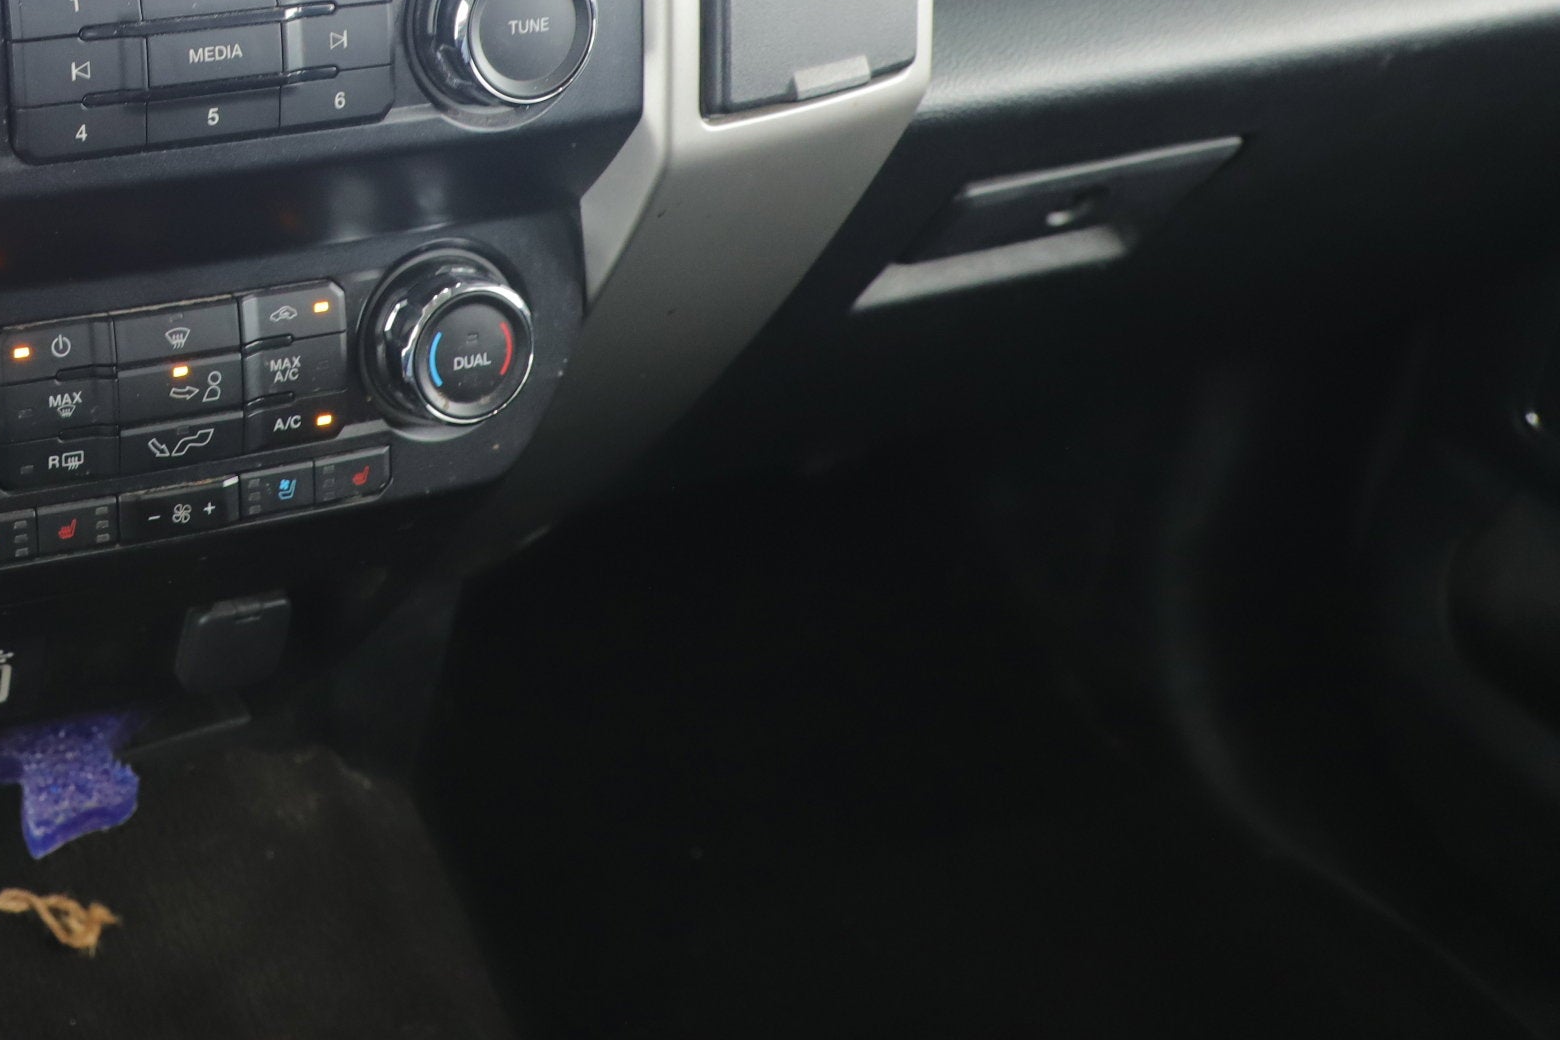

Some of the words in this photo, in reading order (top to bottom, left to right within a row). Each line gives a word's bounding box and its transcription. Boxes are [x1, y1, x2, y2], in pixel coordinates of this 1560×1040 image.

[509, 17, 549, 34] TUNE
[189, 44, 242, 63] MEDIA
[335, 92, 345, 108] 6
[208, 108, 219, 125] 5
[76, 124, 87, 141] 4
[269, 355, 301, 372] MAX
[454, 353, 491, 370] DUAL
[273, 367, 300, 383] A/C
[48, 391, 83, 408] MAX
[274, 415, 301, 431] A/C
[49, 456, 59, 469] R
